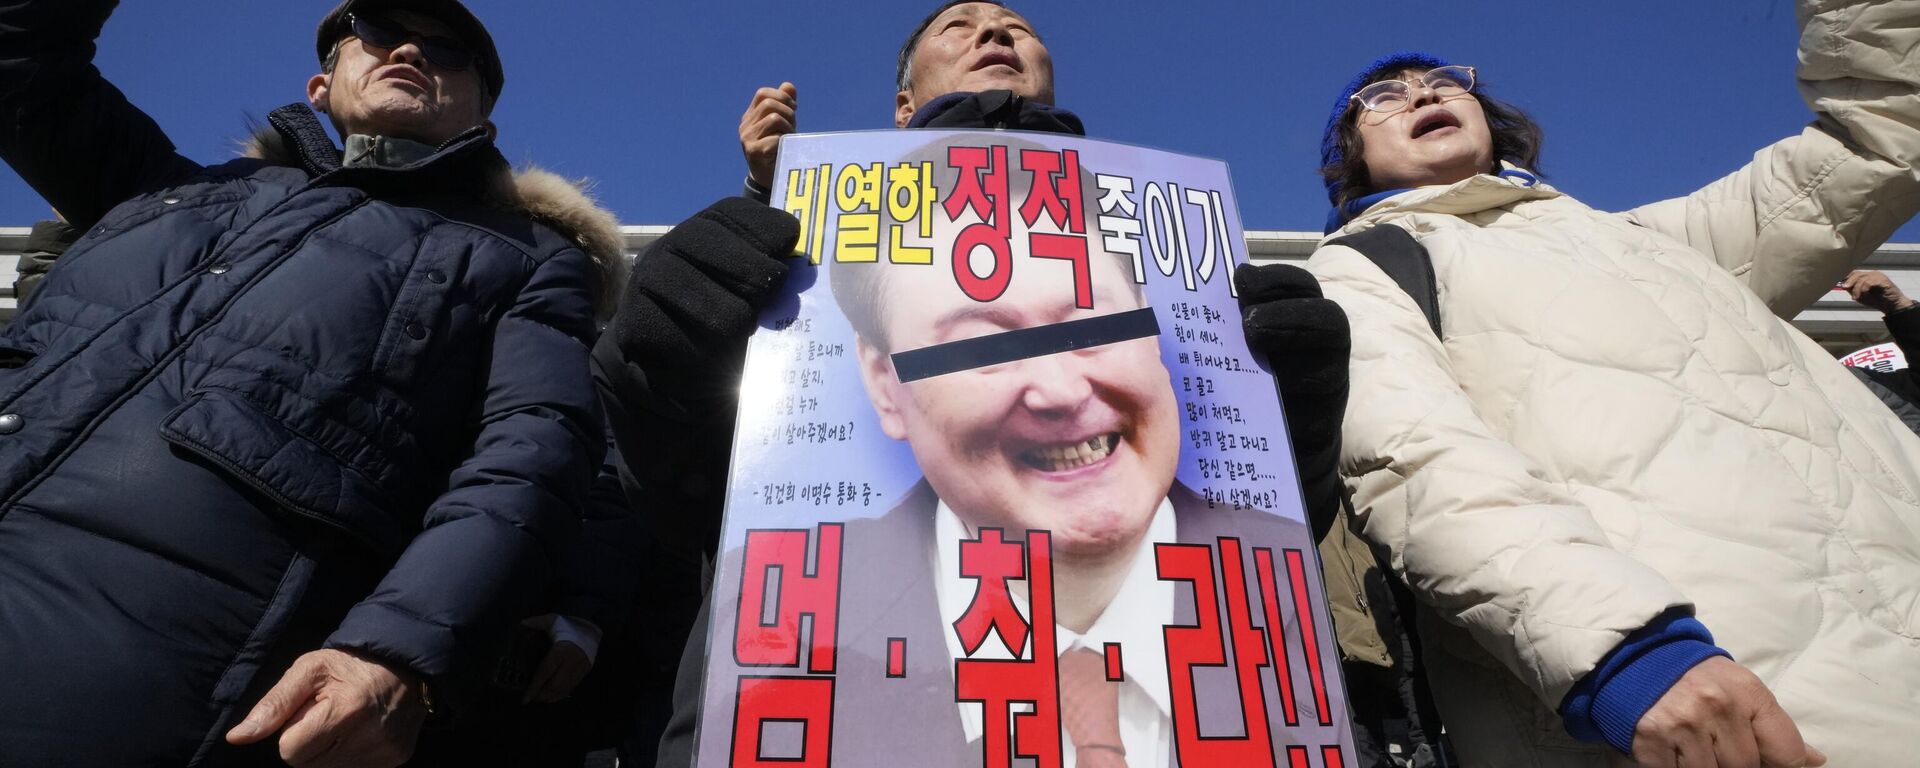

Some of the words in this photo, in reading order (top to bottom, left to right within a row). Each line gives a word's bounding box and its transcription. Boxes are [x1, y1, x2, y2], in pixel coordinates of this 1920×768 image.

[784, 160, 938, 266] 비열한
[942, 145, 1095, 310] 정적
[1096, 172, 1239, 299] 죽이기
[1171, 302, 1200, 321] 인물이
[1202, 304, 1226, 325] 좋나,
[1174, 323, 1195, 343] 힘이
[1199, 330, 1224, 347] 세나,
[808, 340, 844, 362] 들으니까
[1178, 352, 1190, 365] 배
[800, 369, 824, 389] 살지,
[1183, 376, 1192, 393] 코
[1196, 376, 1215, 397] 골고
[799, 396, 818, 414] 누가
[1186, 401, 1208, 423] 많이
[1211, 402, 1246, 426] 처먹고,
[785, 421, 854, 445] 살아주겠어요?
[1190, 428, 1213, 449] 방귀
[1216, 430, 1237, 452] 달고
[1240, 436, 1269, 452] 다니고
[1198, 457, 1221, 479] 당신
[764, 481, 796, 505] 김건희
[801, 482, 832, 506] 이명수
[837, 481, 857, 506] 통화
[862, 482, 871, 506] 중
[1202, 486, 1226, 509] 같이
[1230, 488, 1278, 511] 살겠어요?
